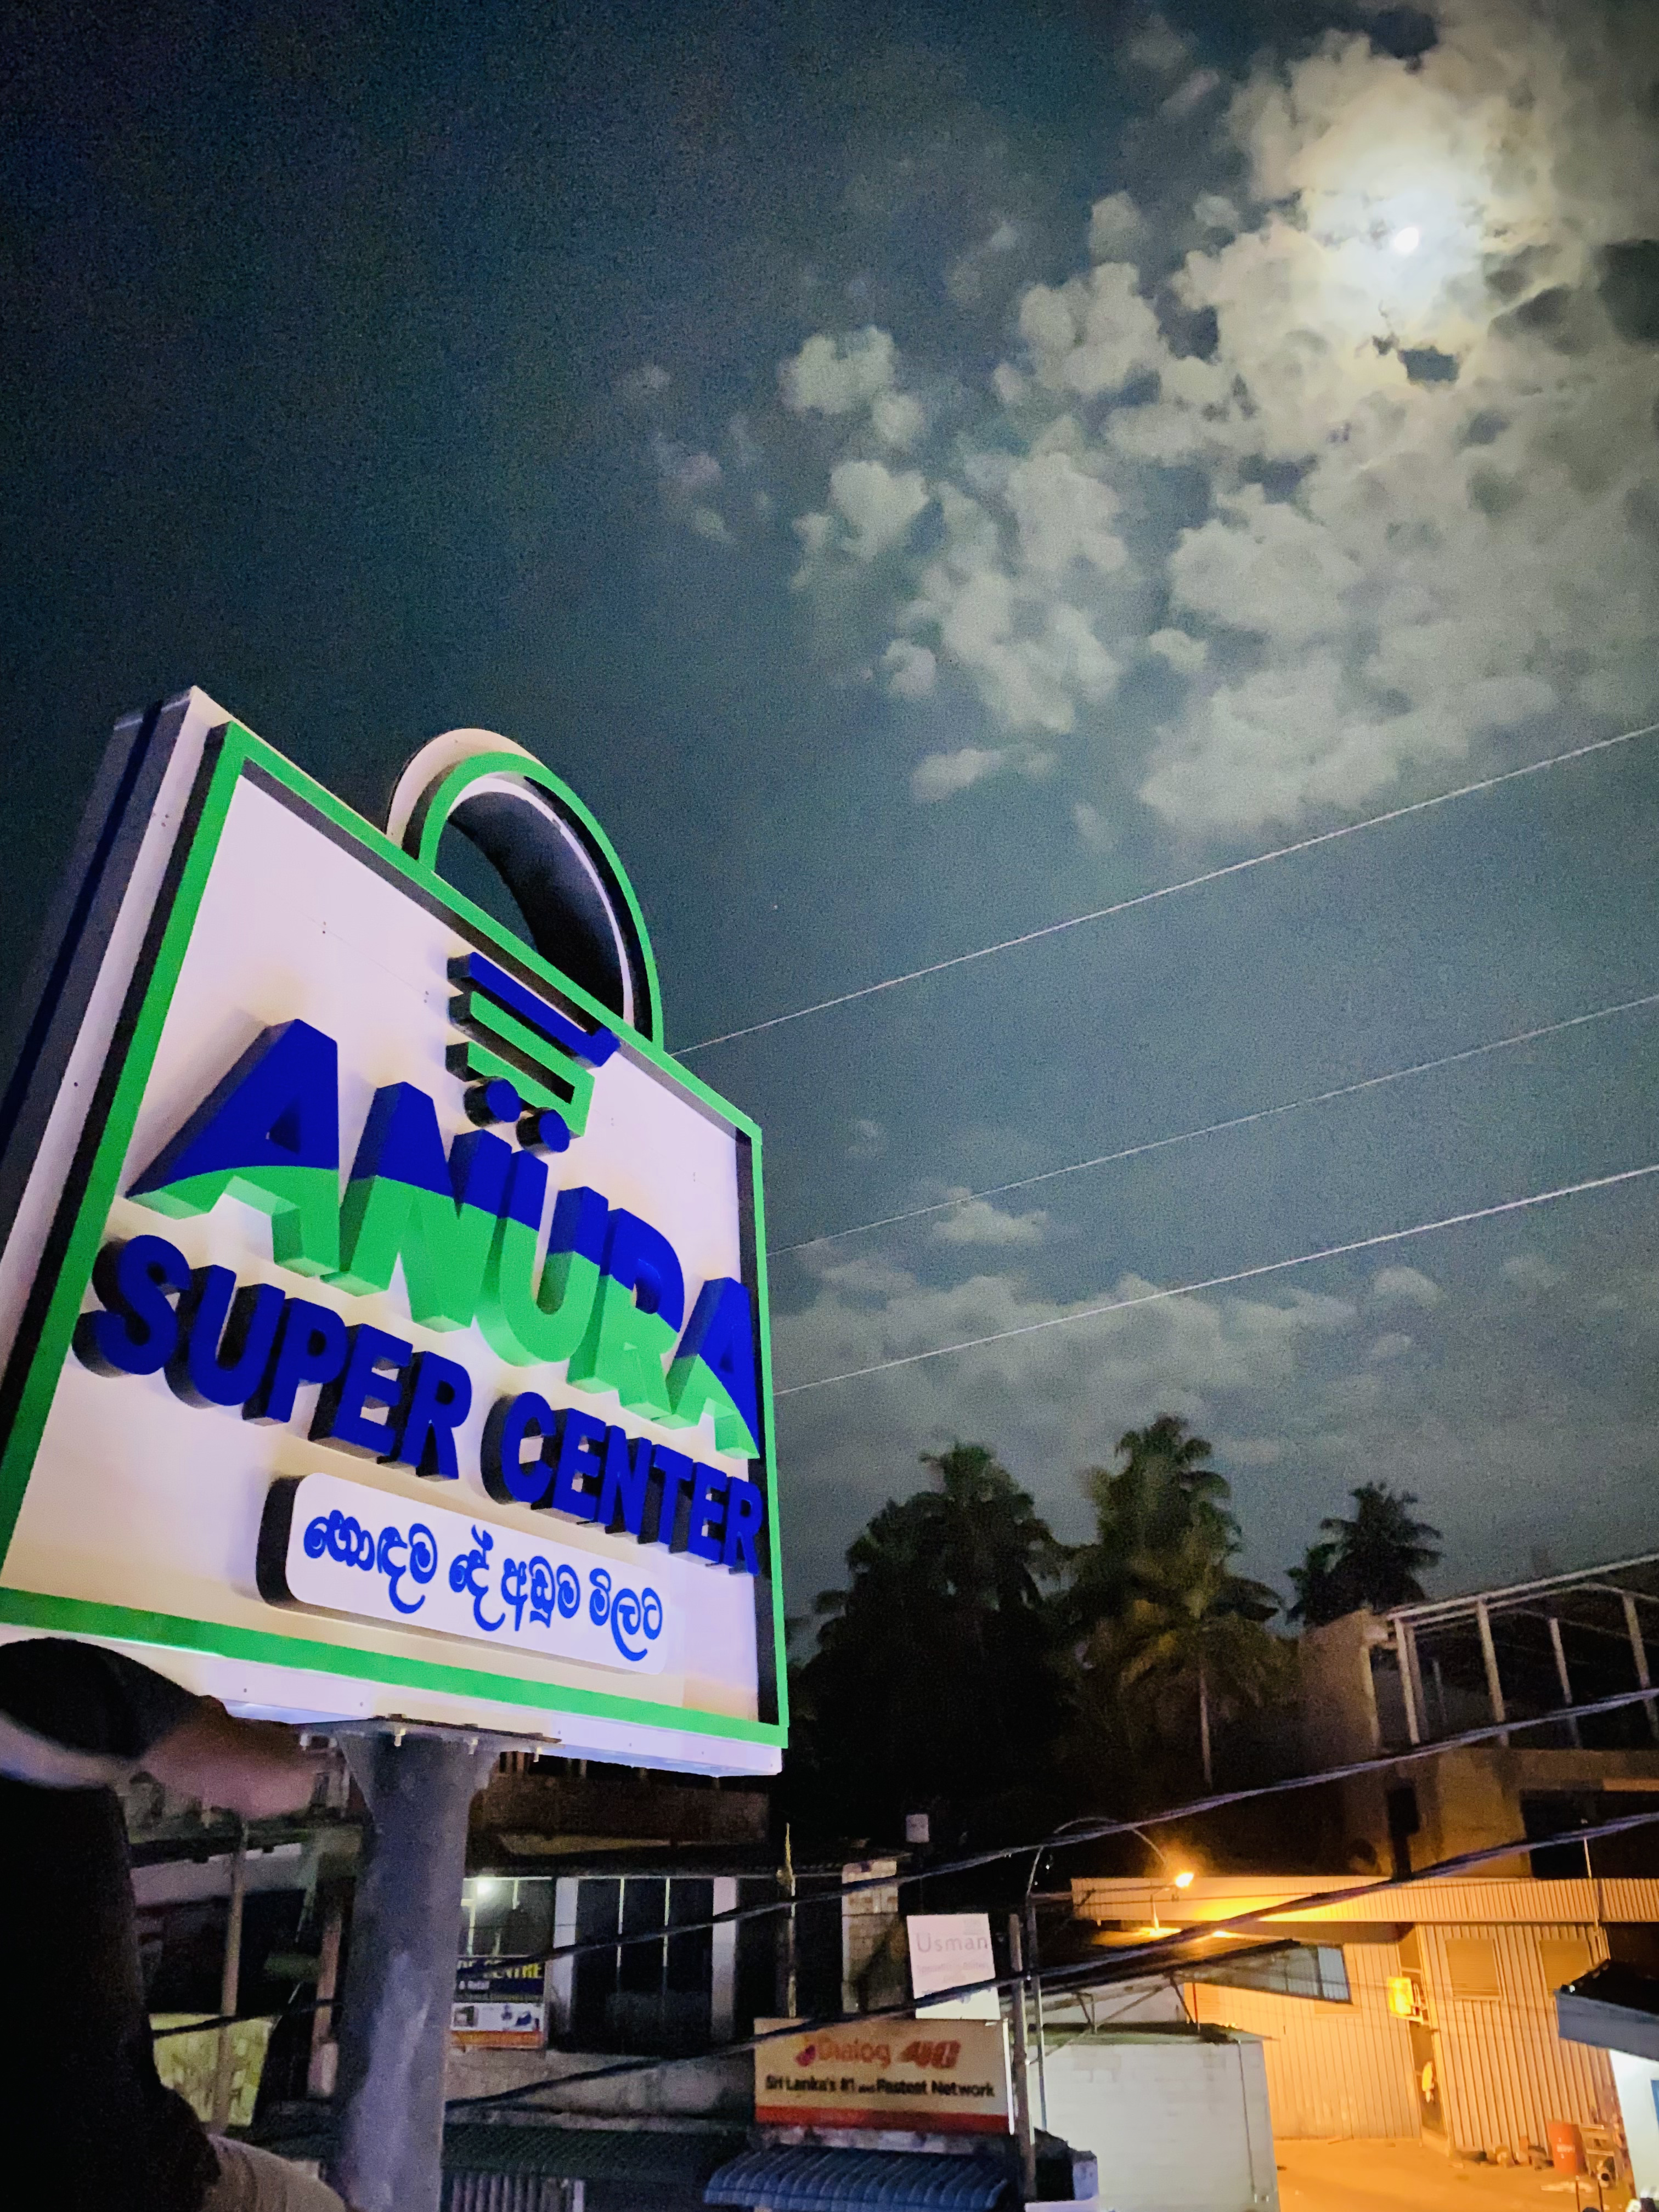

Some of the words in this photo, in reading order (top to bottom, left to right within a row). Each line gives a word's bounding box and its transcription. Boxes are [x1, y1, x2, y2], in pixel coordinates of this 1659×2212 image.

[127, 1019, 761, 1459] ANURA
[73, 1234, 472, 1481] SUPER
[483, 1392, 764, 1576] CENTER
[303, 1509, 438, 1613] හොඳම
[449, 1524, 505, 1632] දේ
[501, 1555, 580, 1632] අඩුම
[589, 1567, 663, 1661] මිලට
[916, 1931, 989, 1953] Usman
[766, 2074, 783, 2089] Sri
[932, 2080, 995, 2097] Network
